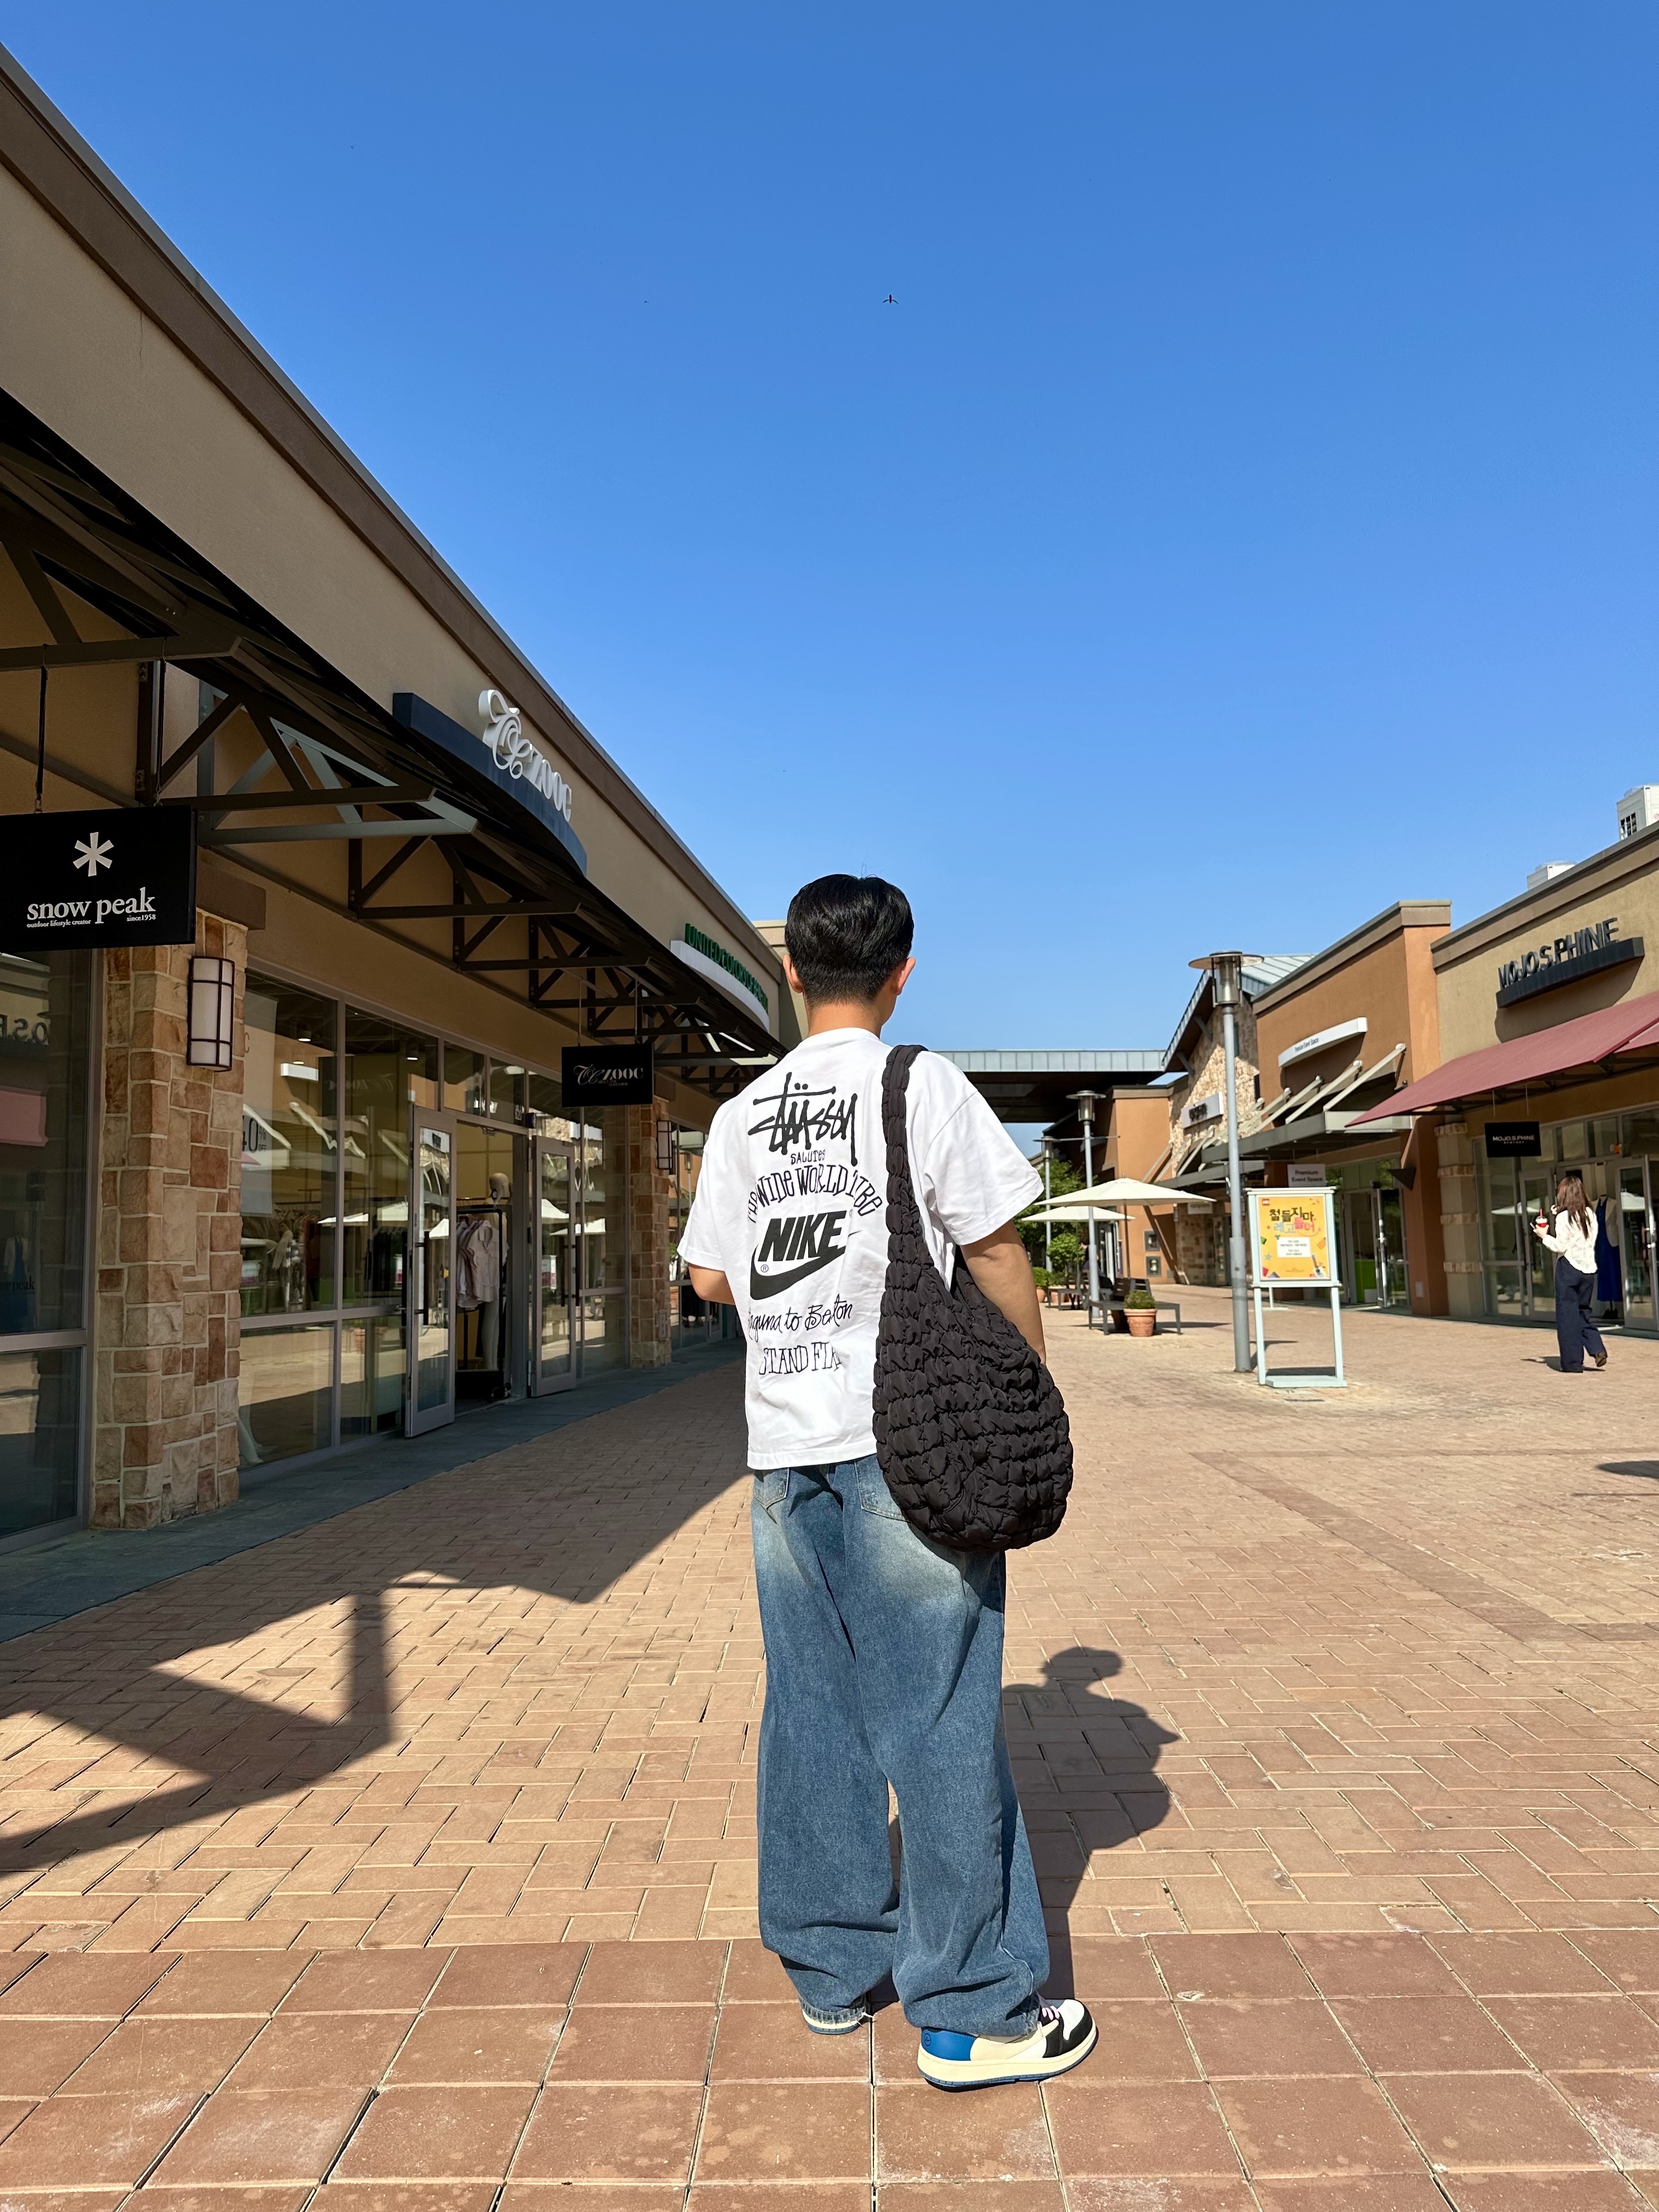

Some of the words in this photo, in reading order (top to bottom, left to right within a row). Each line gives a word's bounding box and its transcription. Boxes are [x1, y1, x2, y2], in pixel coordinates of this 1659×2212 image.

[27, 901, 92, 920] snow
[95, 887, 156, 924] peak
[602, 1067, 644, 1081] ZOOC
[794, 1164, 848, 1196] WORLD
[758, 1210, 847, 1261] NIKE
[784, 1307, 802, 1331] to
[759, 1345, 808, 1375] STAND
